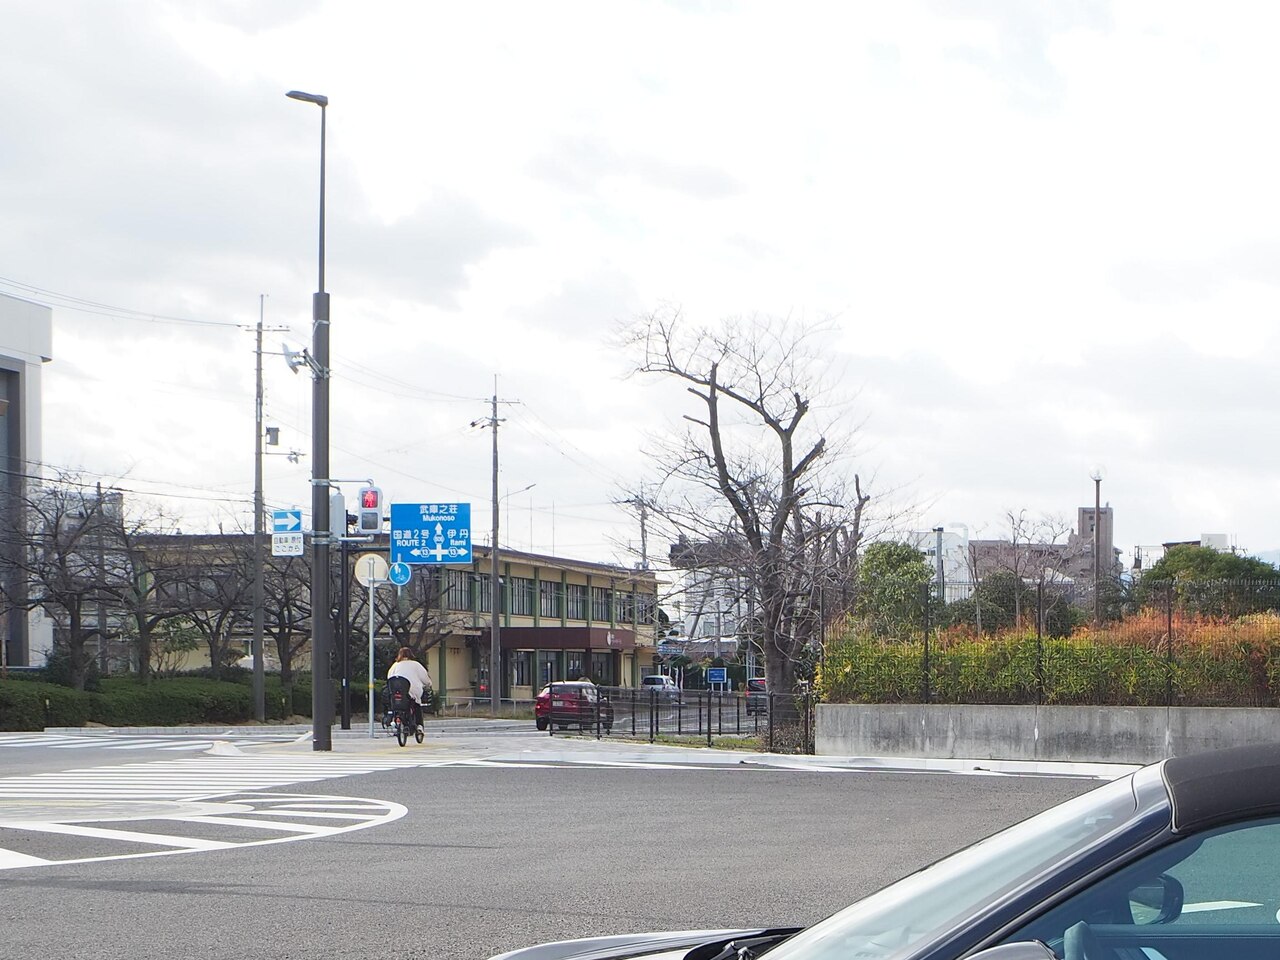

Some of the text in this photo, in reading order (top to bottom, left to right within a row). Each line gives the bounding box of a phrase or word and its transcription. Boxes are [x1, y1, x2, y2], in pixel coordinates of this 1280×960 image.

[422, 514, 455, 522] Mukonoso
[447, 529, 469, 539] 伊丹
[396, 539, 419, 547] ROUTE
